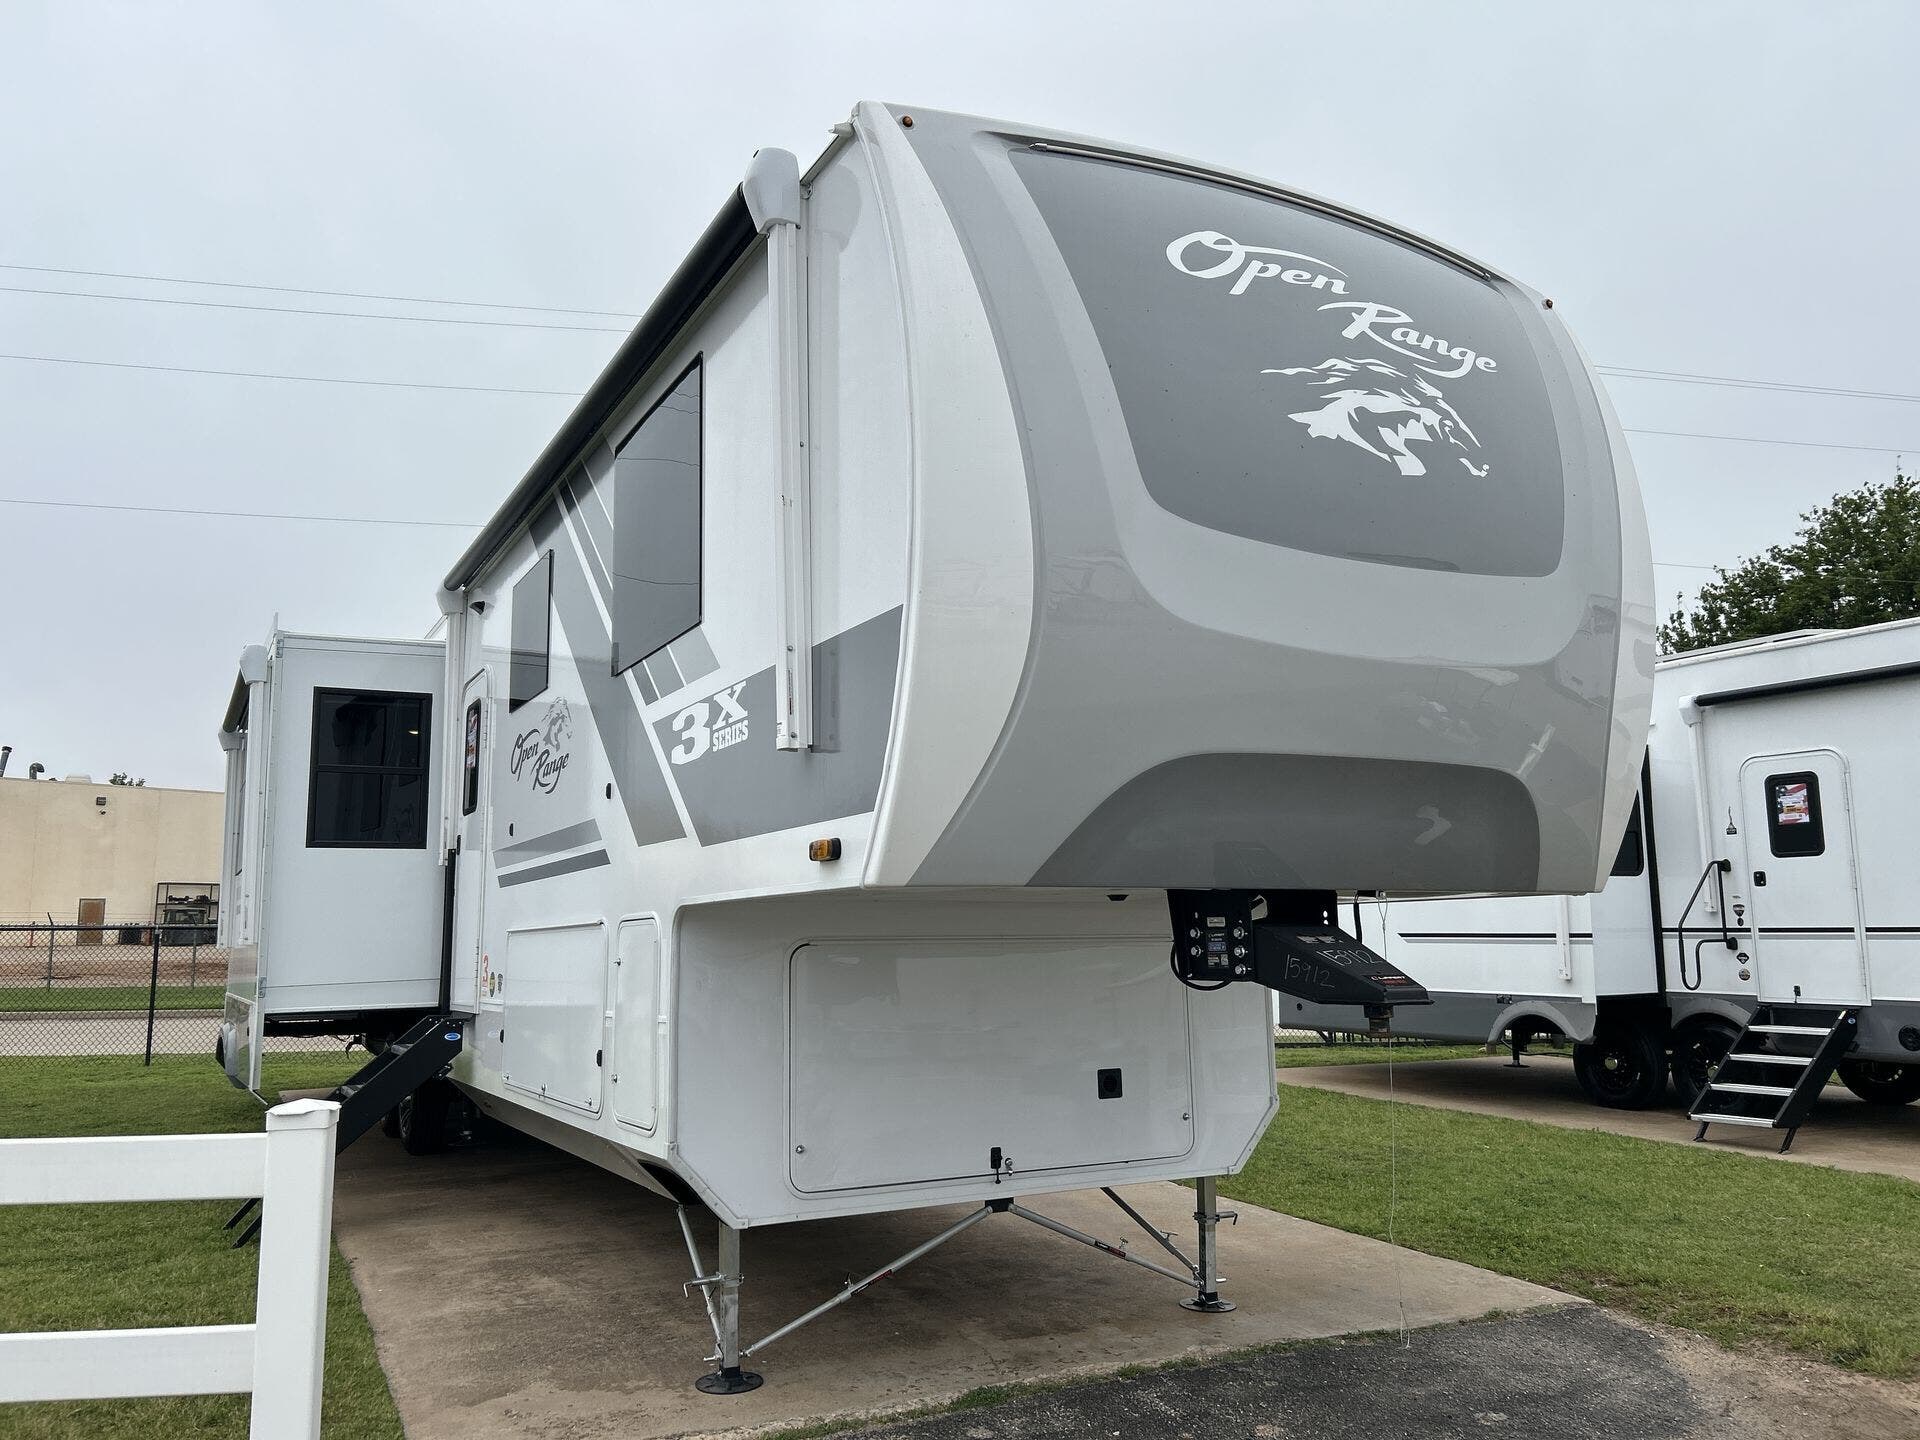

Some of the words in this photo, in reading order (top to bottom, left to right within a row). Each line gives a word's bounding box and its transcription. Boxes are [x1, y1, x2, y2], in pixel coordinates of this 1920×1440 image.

[1166, 231, 1349, 295] Open
[1316, 302, 1497, 378] Range
[511, 729, 540, 782] Open
[713, 720, 749, 752] SERIES
[530, 749, 570, 794] Range
[1284, 954, 1336, 988] 15912
